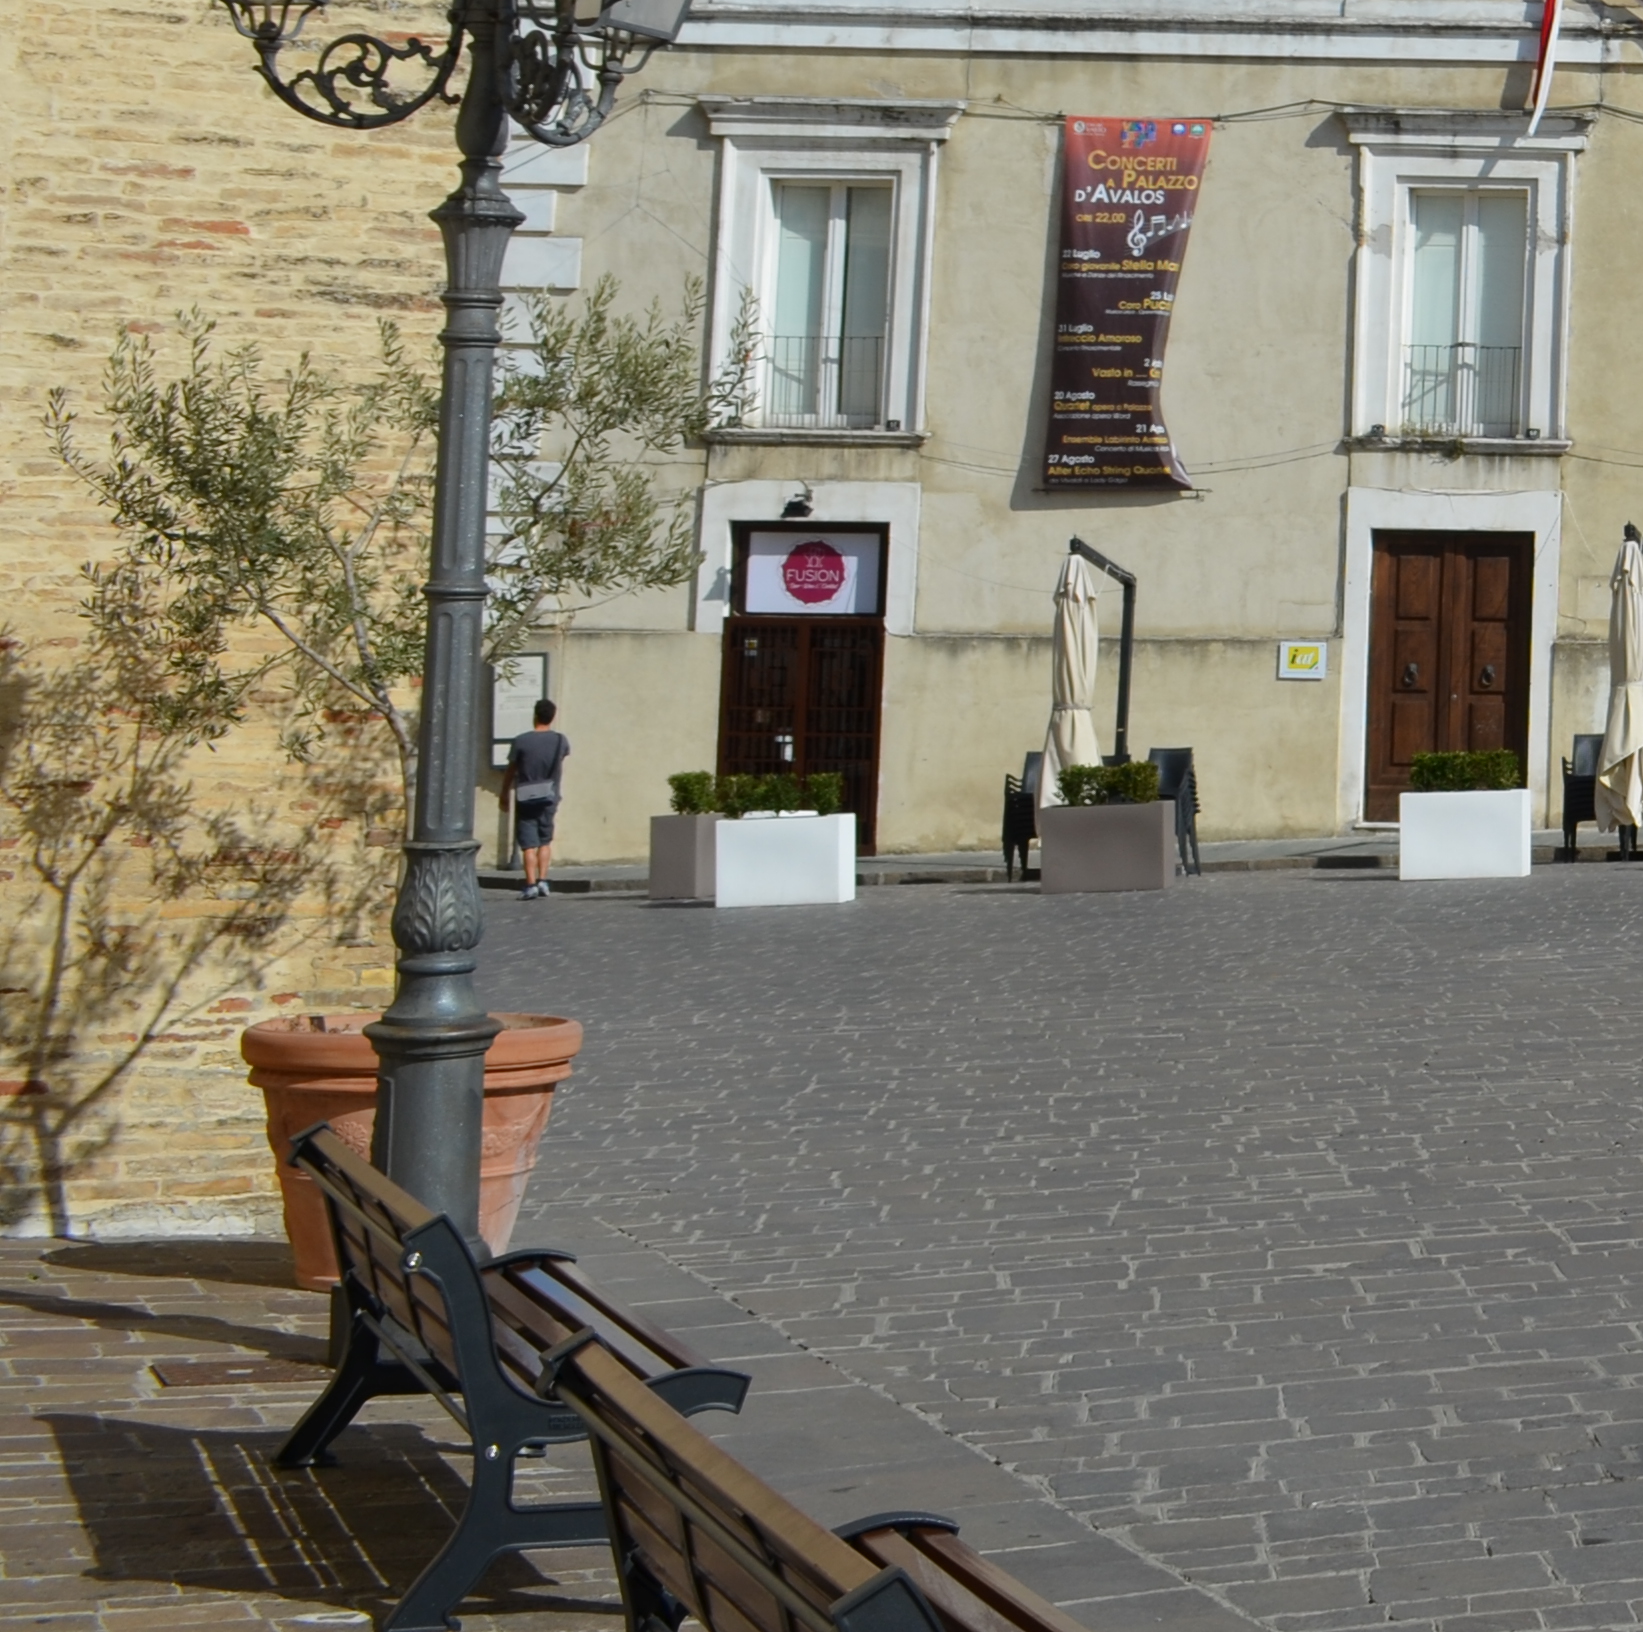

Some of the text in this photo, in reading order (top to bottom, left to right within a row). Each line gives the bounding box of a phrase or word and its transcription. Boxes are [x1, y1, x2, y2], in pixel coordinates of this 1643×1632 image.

[1088, 150, 1177, 170] CONCERTI
[1106, 170, 1198, 190] A PALAZZO
[1074, 184, 1165, 204] D'AVALOS
[1073, 249, 1101, 260] Luglio
[1081, 262, 1120, 272] giovanile
[1121, 260, 1154, 271] Stella
[1118, 301, 1142, 310] Coro
[1069, 324, 1094, 334] Luglio
[1098, 333, 1142, 343] Amoroso
[1092, 368, 1122, 378] Vasto
[1065, 391, 1096, 401] Agosto
[1062, 435, 1103, 444] Ensemble
[1104, 435, 1140, 444] Labirinto
[1061, 455, 1095, 465] Agosto
[1075, 466, 1101, 475] Echo
[1103, 466, 1131, 476] String
[786, 569, 839, 582] FUSION
